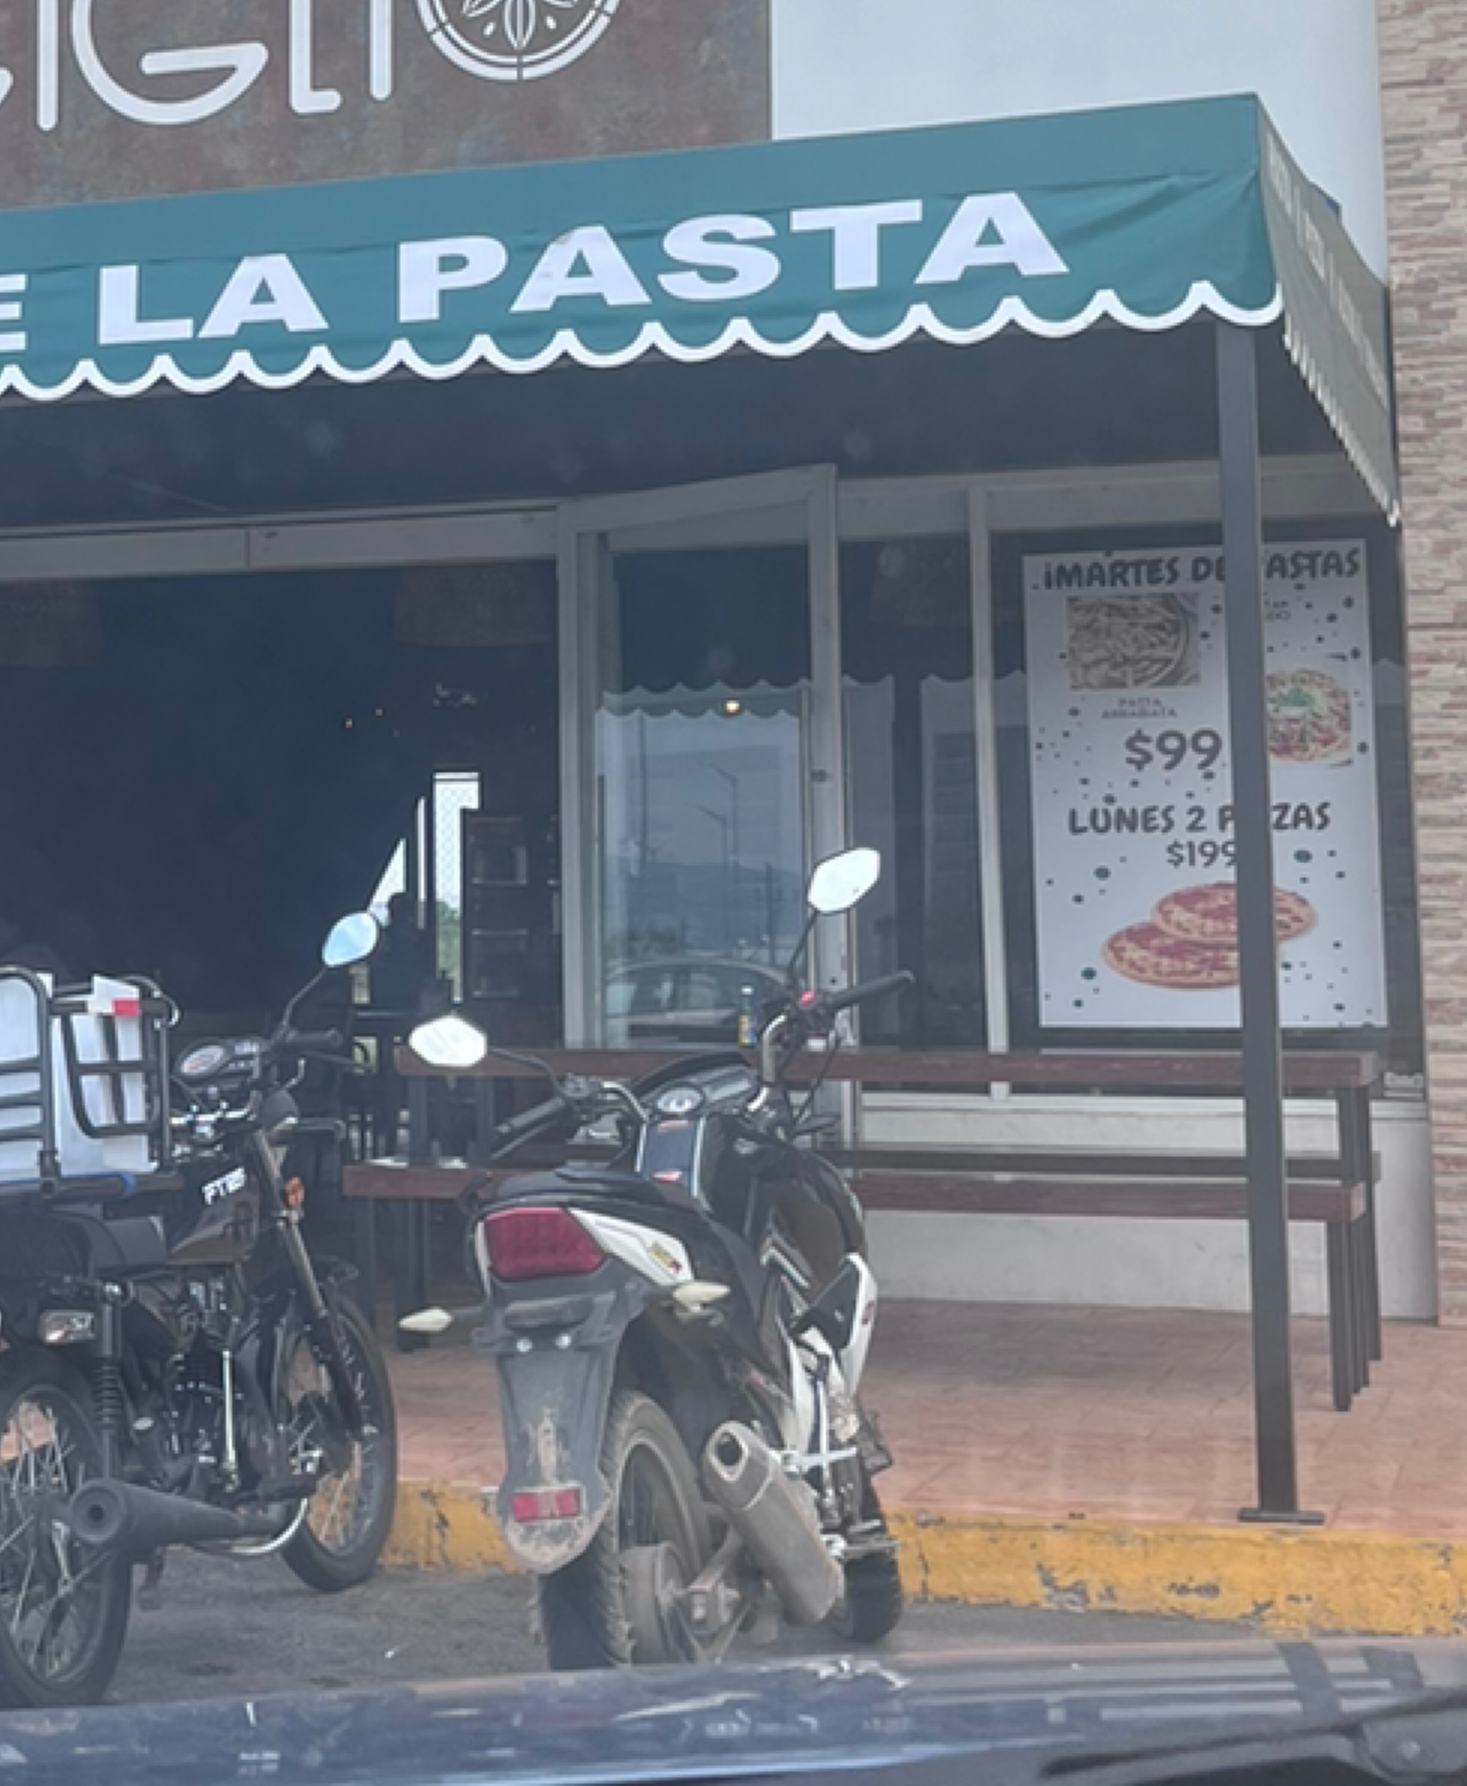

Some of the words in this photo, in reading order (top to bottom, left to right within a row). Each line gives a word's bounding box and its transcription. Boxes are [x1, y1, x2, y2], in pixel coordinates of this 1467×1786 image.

[98, 253, 329, 345] LA
[399, 191, 1070, 323] PASTA
[1191, 556, 1225, 583] DE
[1266, 547, 1360, 579] ASTAS
[1124, 728, 1222, 771] $99
[1068, 804, 1175, 834] LUNES
[1186, 805, 1207, 833] 2
[1218, 801, 1331, 833] PZAS
[1166, 840, 1235, 869] $199
